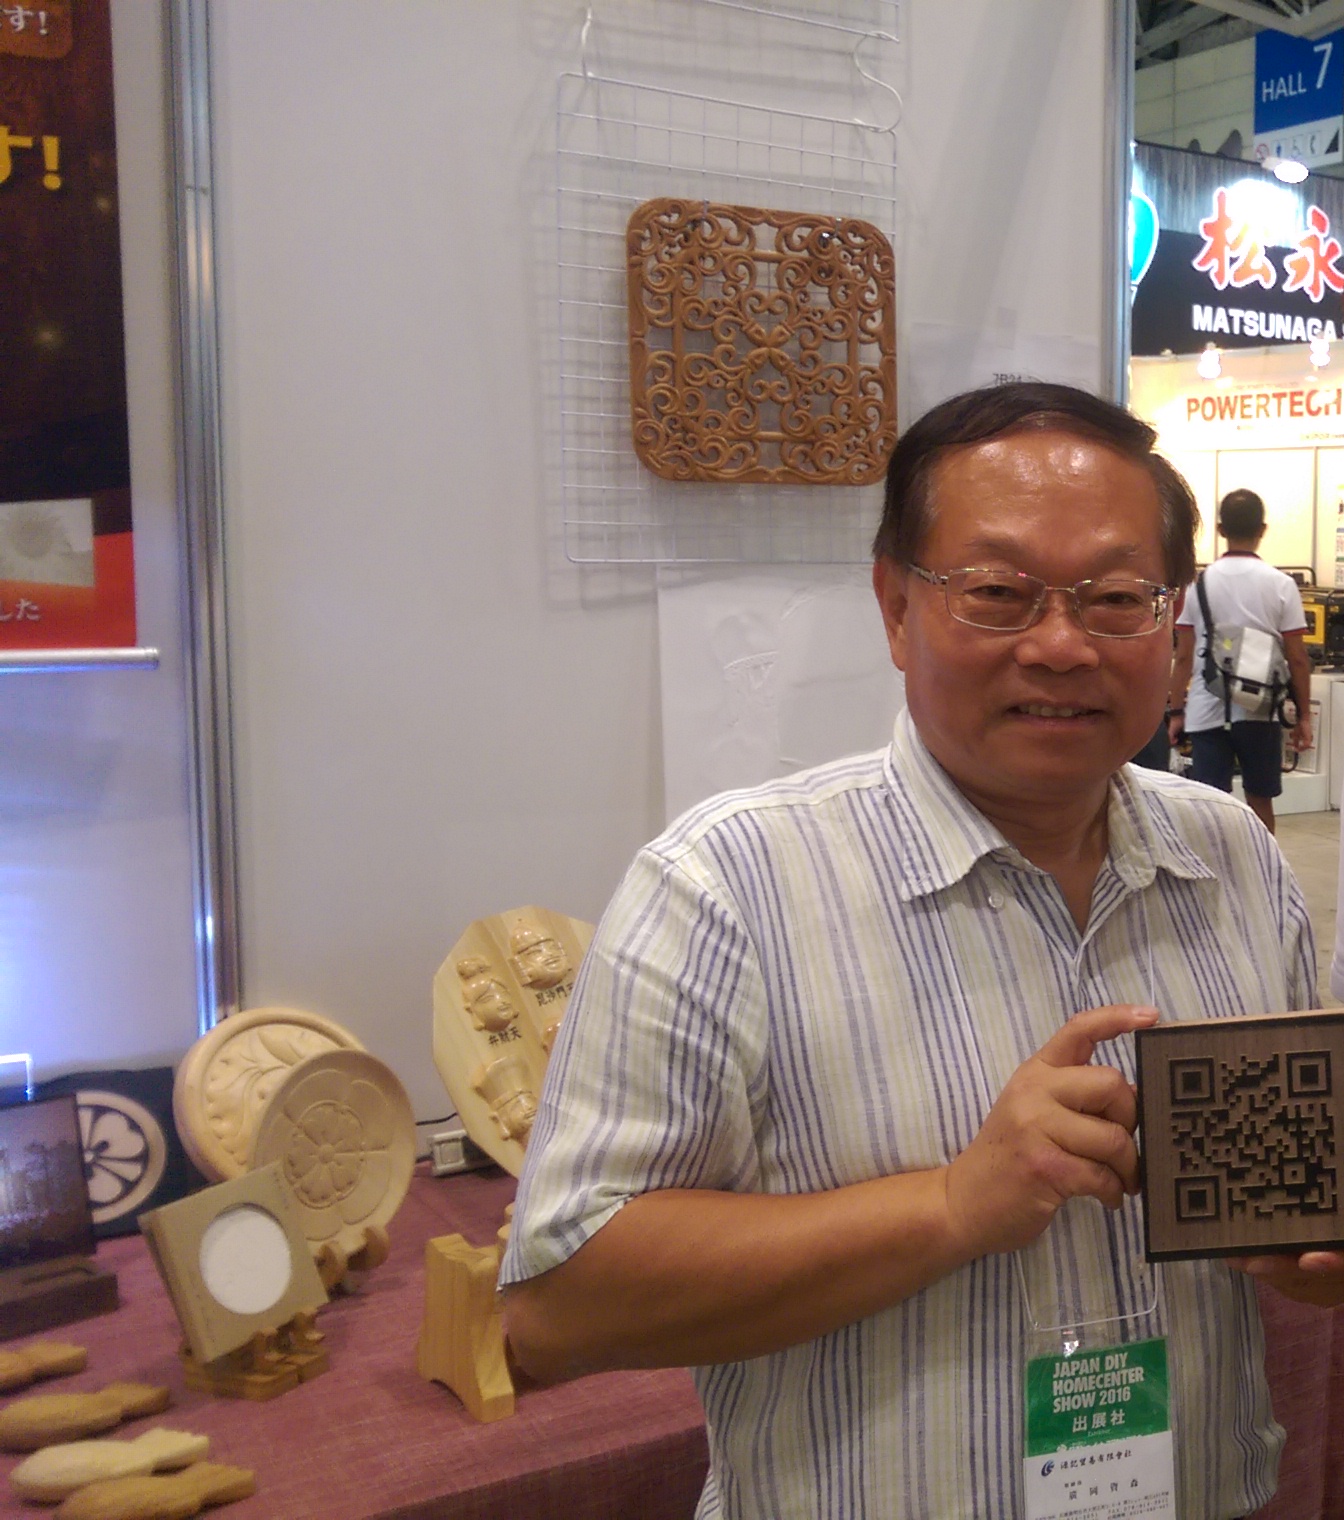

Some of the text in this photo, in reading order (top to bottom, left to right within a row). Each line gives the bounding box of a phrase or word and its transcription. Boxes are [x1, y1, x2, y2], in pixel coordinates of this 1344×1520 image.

[1262, 41, 1333, 103] HALL 7
[1192, 304, 1337, 341] MATSUNAGA
[1187, 388, 1342, 422] POWERTECH
[1053, 1352, 1128, 1379] JAPAN DIY
[1052, 1366, 1144, 1397] HOMECENTER
[1053, 1386, 1131, 1414] SHOW 2016
[1072, 1408, 1125, 1433] 出展社
